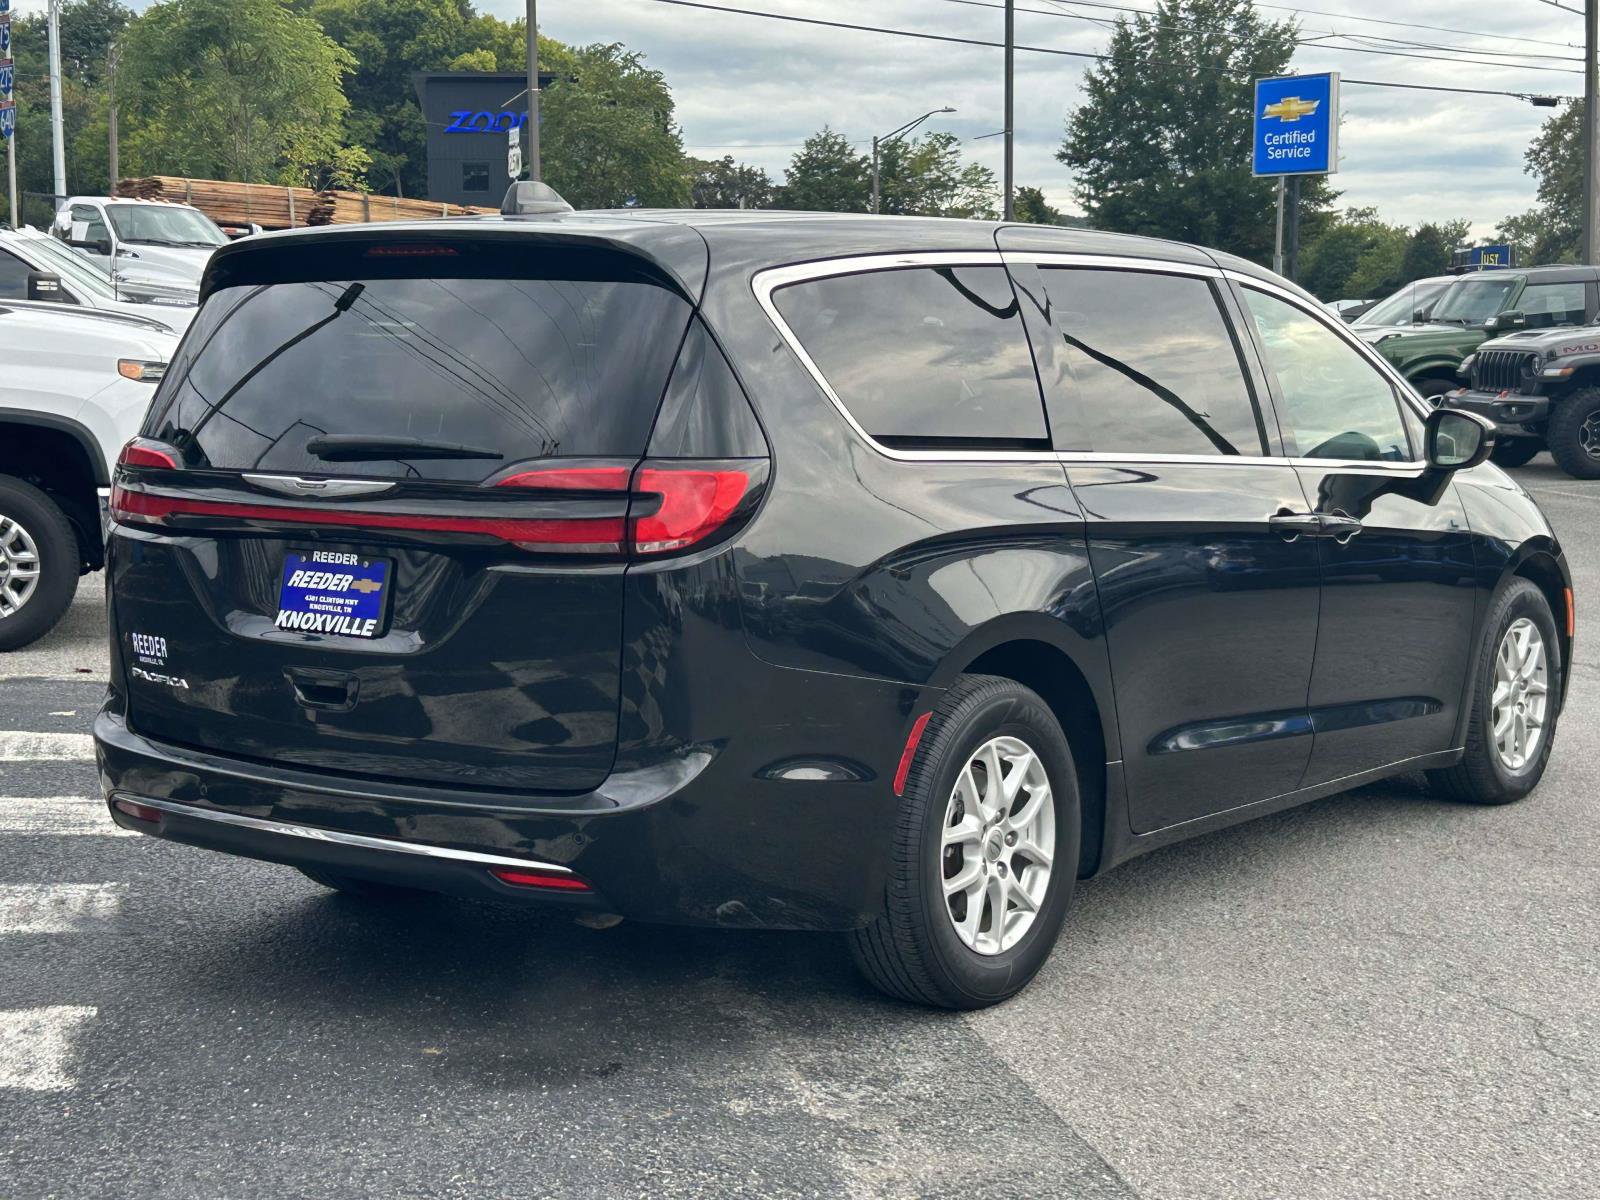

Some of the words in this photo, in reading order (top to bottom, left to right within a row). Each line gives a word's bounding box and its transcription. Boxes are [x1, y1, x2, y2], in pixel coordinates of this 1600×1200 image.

[0, 67, 13, 88] 275
[0, 109, 15, 130] 640
[1264, 129, 1316, 146] Certified
[1267, 145, 1311, 160] Service
[312, 550, 358, 566] REEDER
[287, 569, 354, 592] REEDER
[274, 609, 377, 637] KNOXVILLE
[132, 632, 168, 658] REEDER
